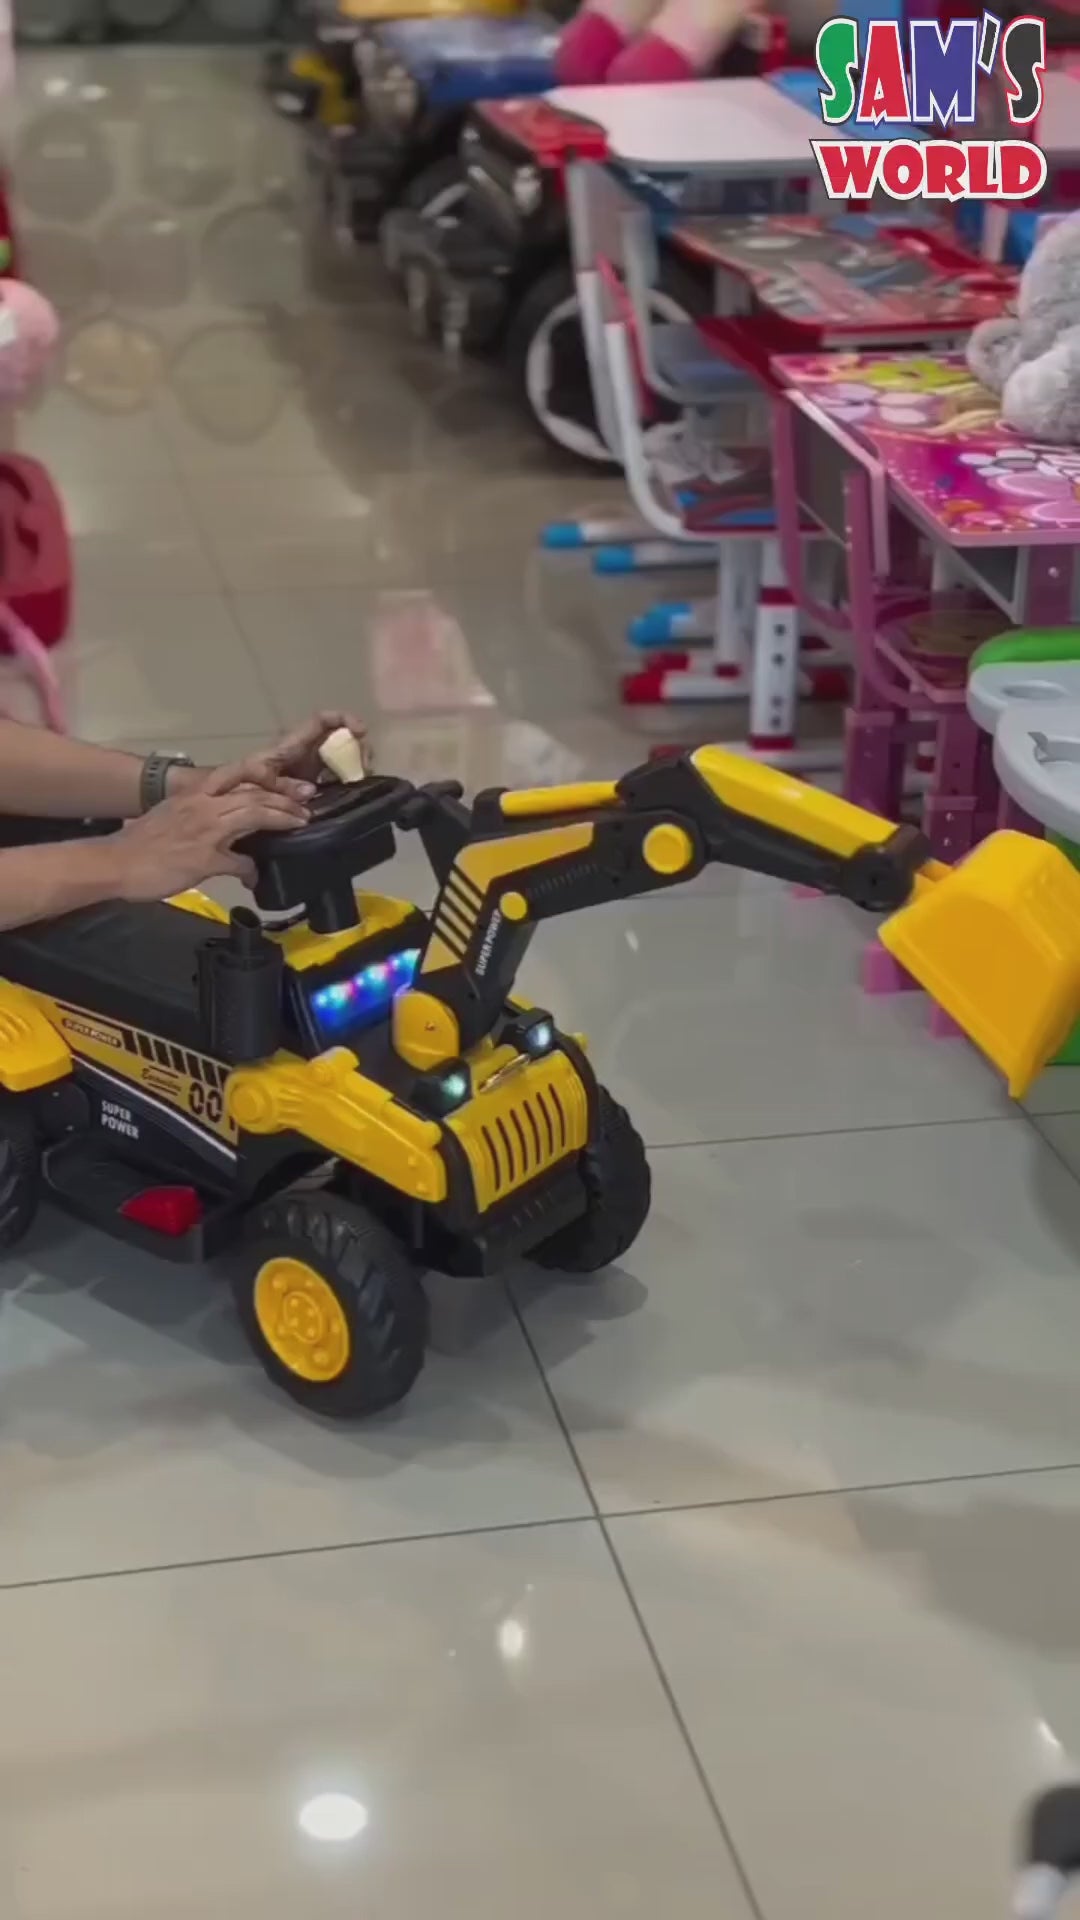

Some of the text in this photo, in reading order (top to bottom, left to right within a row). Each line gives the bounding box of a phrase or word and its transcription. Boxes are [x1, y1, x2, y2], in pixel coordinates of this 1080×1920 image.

[475, 944, 493, 976] SUPER
[101, 1100, 131, 1121] SUPER
[101, 1113, 139, 1140] POWER
